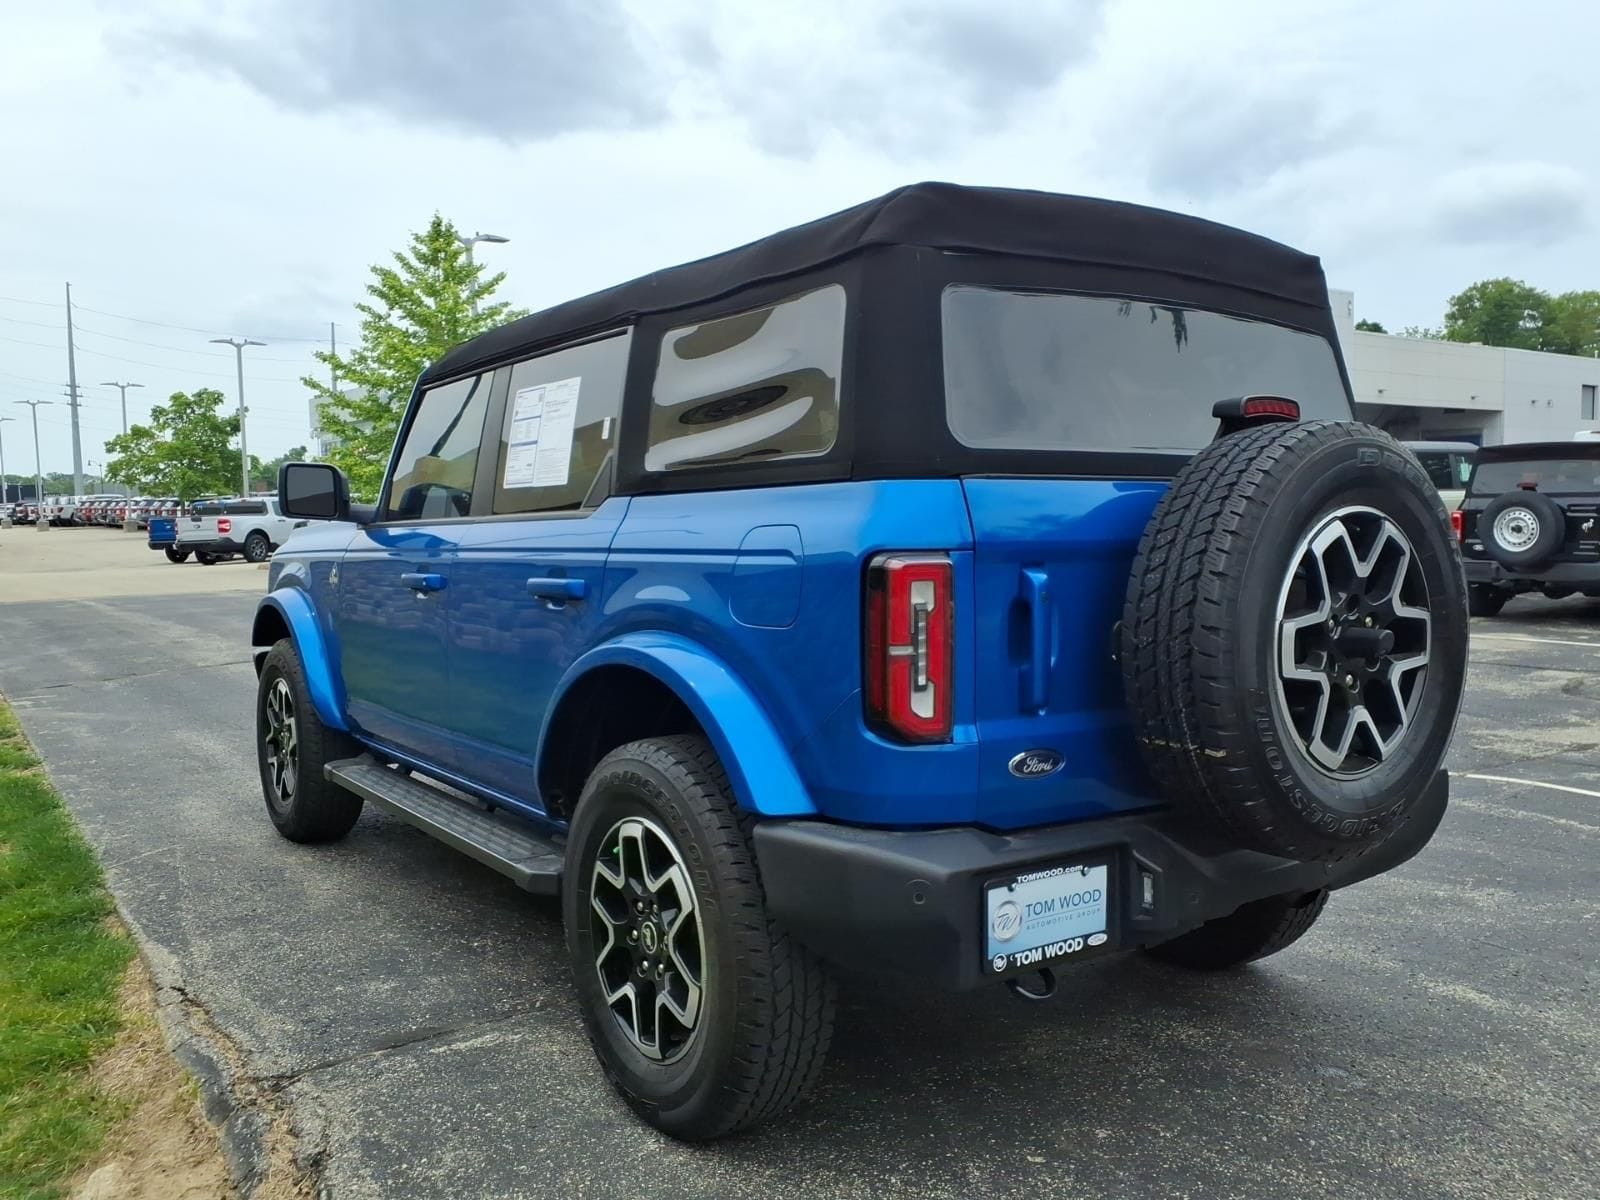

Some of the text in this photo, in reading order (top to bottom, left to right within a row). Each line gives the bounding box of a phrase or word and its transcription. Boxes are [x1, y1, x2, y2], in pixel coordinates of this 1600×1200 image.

[1023, 756, 1054, 773] Ford
[1016, 864, 1083, 884] TOMWOOD.com
[1025, 888, 1102, 917] TOM WOOD
[1026, 907, 1101, 930] AUTOMOTIVE GROUP
[1014, 946, 1042, 967] TOM
[1044, 937, 1084, 959] WOOD
